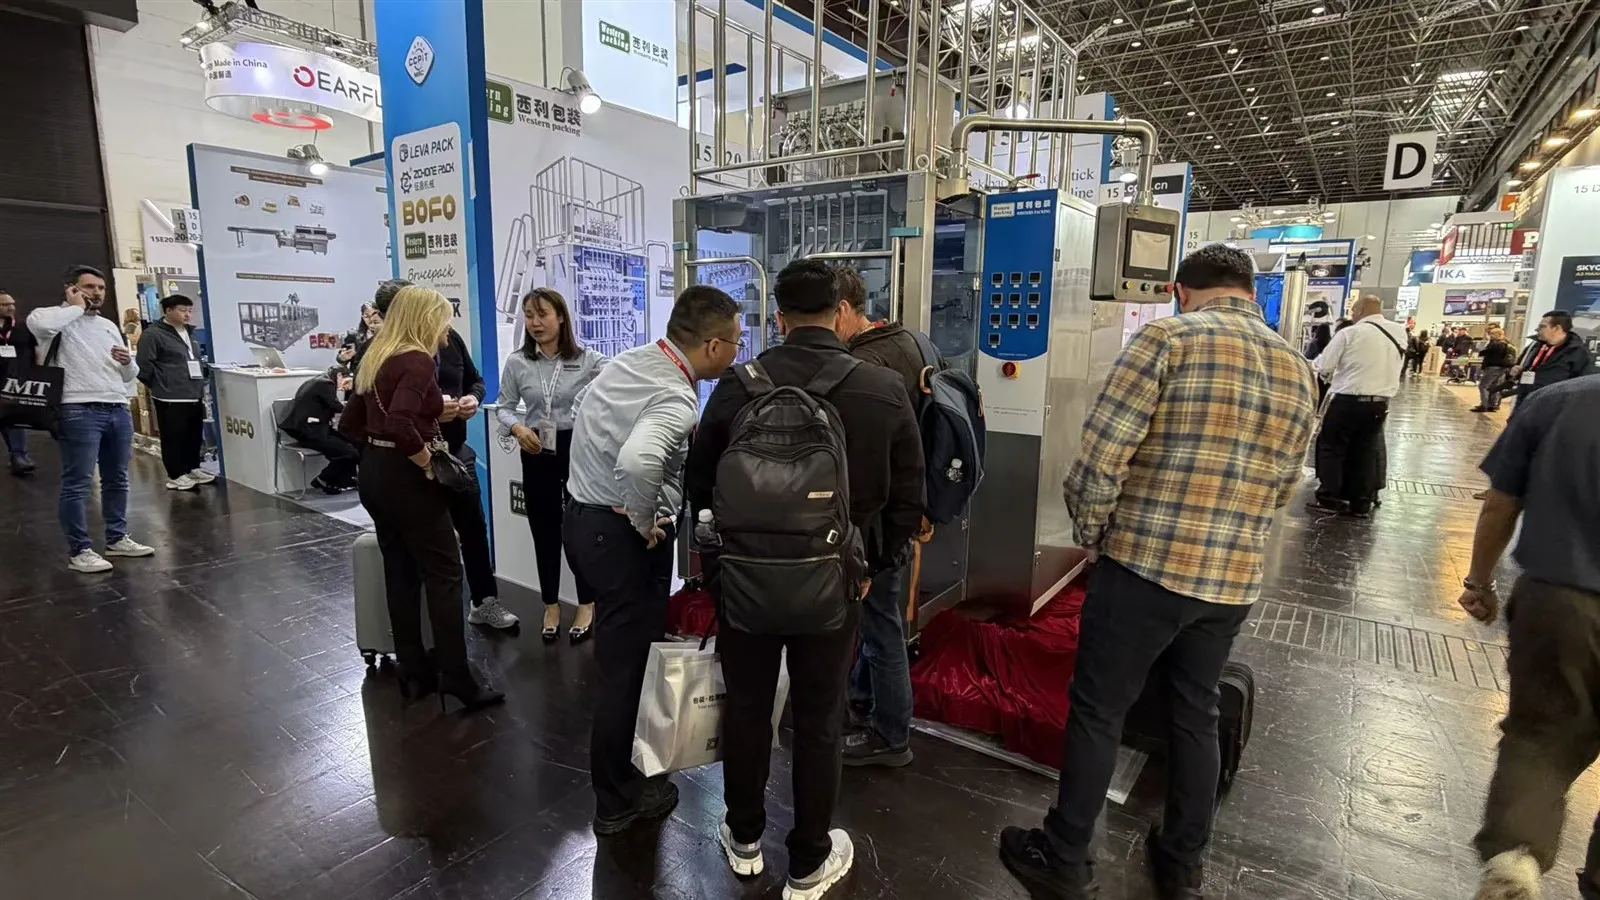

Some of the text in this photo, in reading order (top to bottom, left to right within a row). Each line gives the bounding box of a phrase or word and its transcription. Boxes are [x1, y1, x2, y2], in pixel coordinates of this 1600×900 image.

[602, 23, 625, 40] Western
[601, 34, 629, 52] packing
[632, 36, 669, 60] 西利包装
[214, 59, 231, 67] Made
[233, 58, 241, 66] in
[242, 59, 268, 68] China
[409, 53, 429, 66] CCPIT
[516, 93, 582, 127] 西利包装
[518, 113, 581, 137] Western packing
[410, 137, 454, 159] LEVA PACK
[1392, 142, 1427, 180] D
[1107, 188, 1119, 198] 15
[1574, 185, 1588, 194] 15
[188, 212, 198, 220] 15
[402, 194, 457, 226] BOFO
[428, 233, 458, 248] 西利包装
[1189, 231, 1198, 239] 15
[408, 263, 456, 283] Brucepack
[1440, 269, 1466, 279] IKA
[225, 415, 255, 439] BOFO
